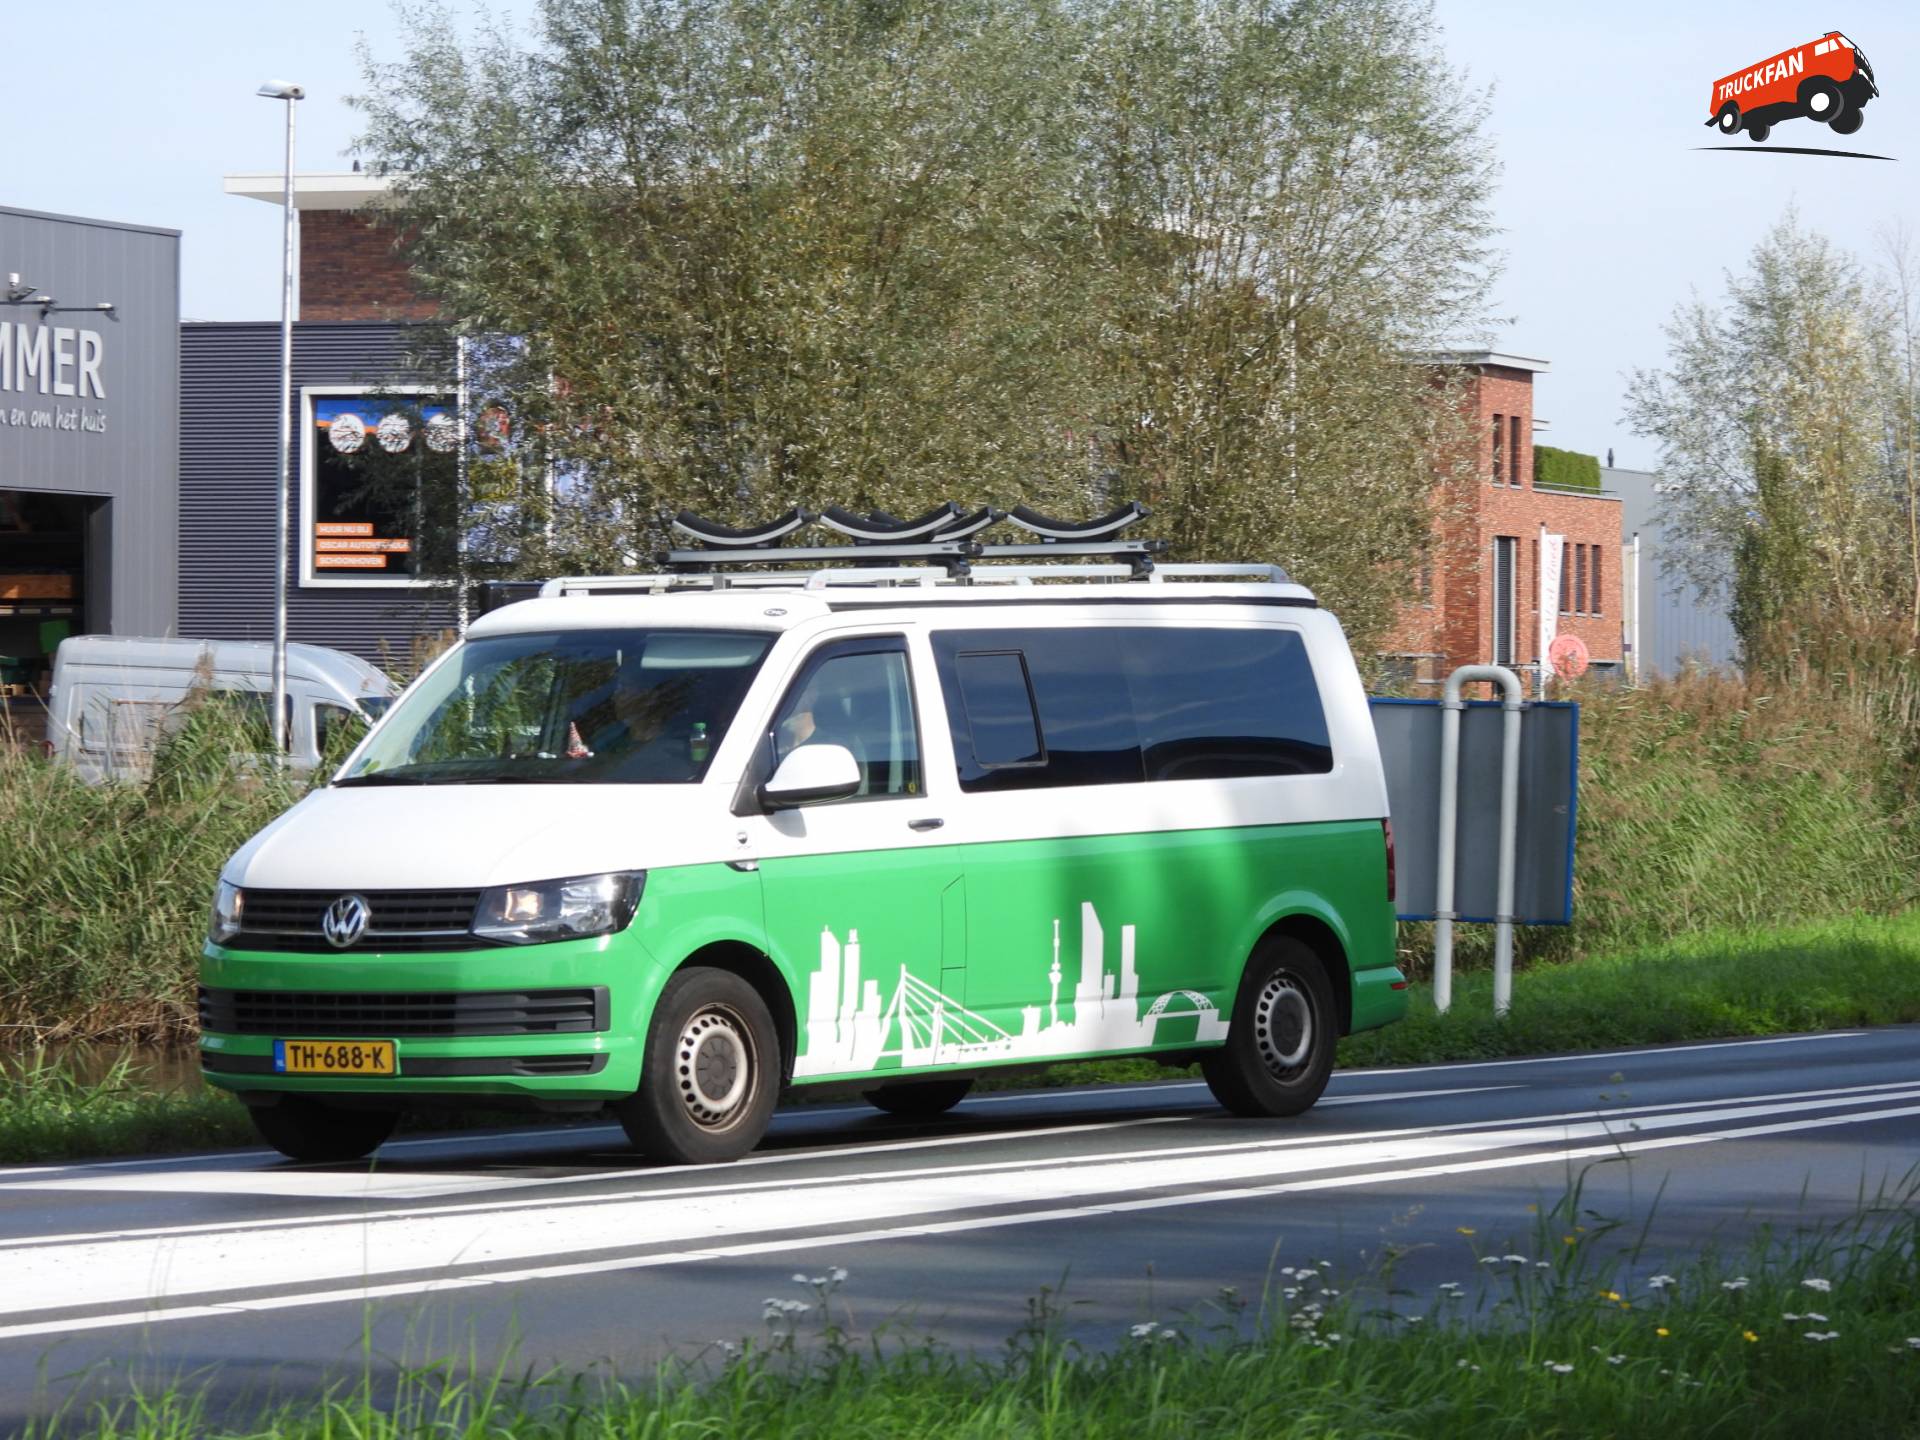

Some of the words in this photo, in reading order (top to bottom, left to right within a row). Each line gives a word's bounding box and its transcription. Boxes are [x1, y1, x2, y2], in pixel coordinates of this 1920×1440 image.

[10, 408, 27, 426] en
[30, 409, 52, 429] om
[55, 404, 78, 431] het
[80, 406, 106, 433] huis
[289, 1045, 385, 1070] TH-688-K
